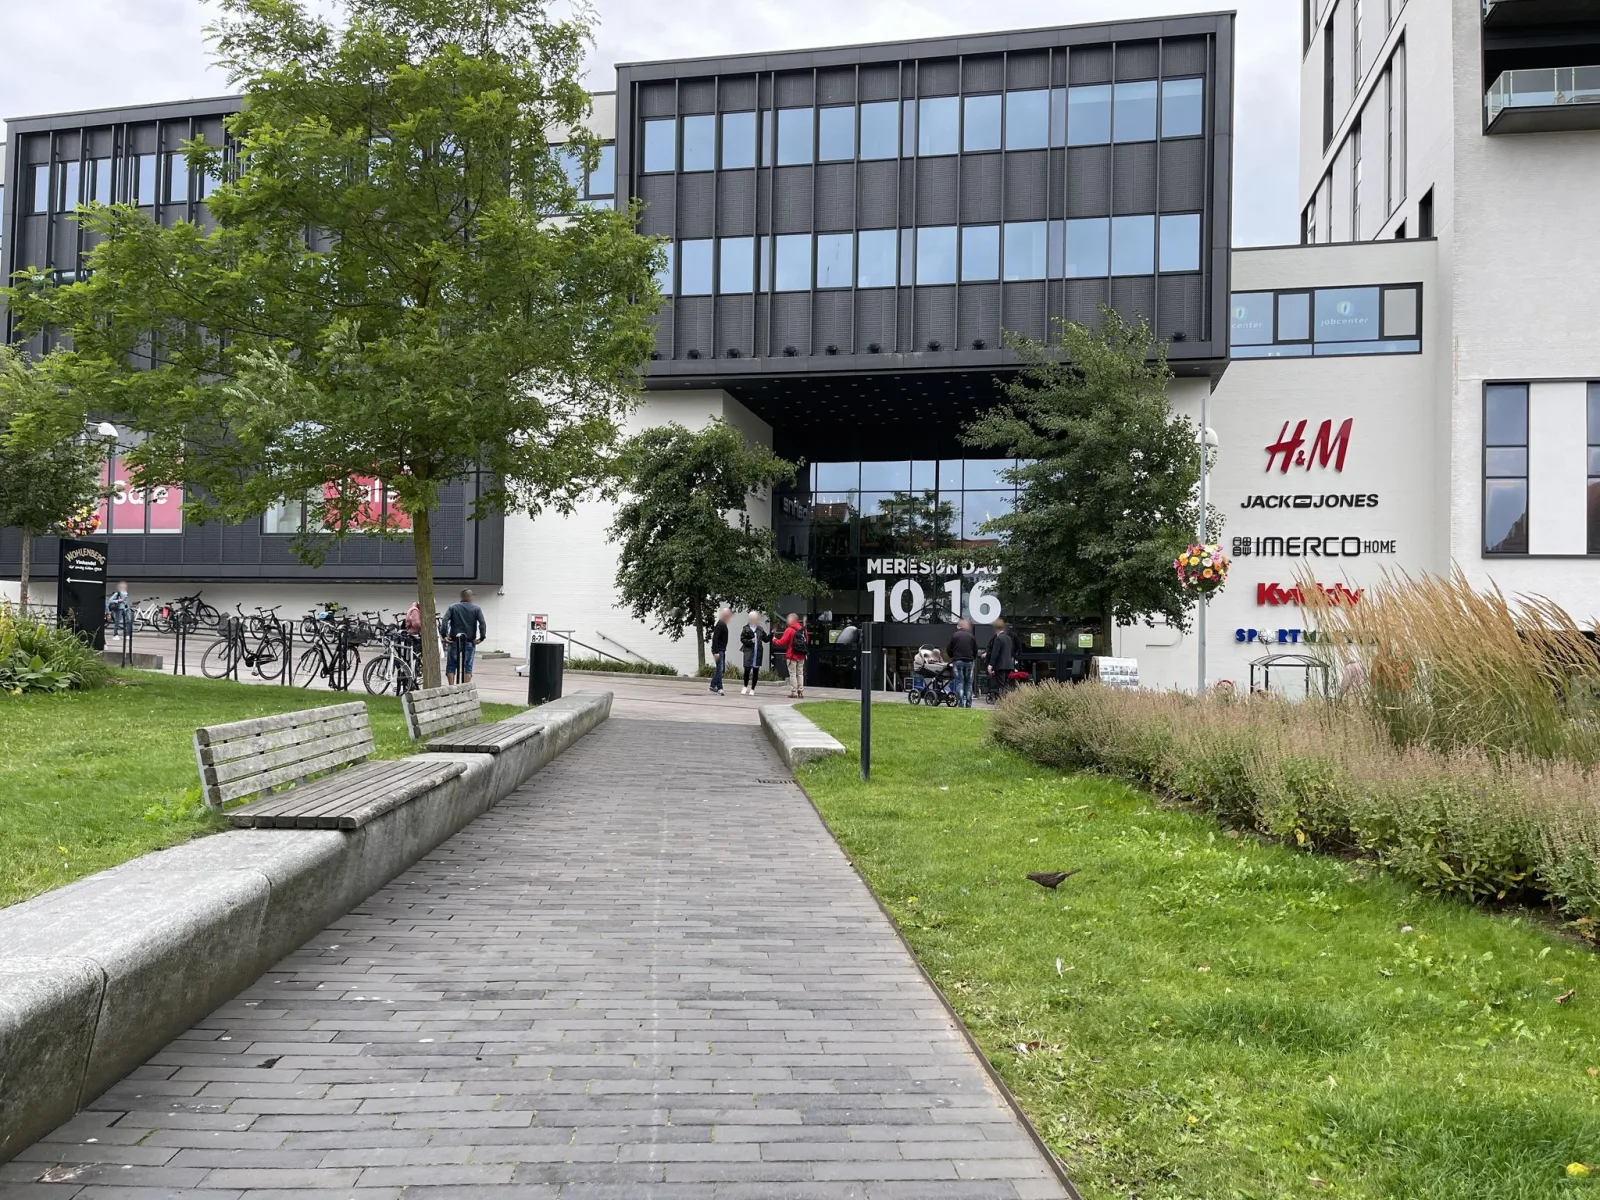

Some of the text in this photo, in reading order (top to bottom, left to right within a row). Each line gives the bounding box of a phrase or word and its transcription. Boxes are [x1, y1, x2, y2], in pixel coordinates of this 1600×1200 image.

[1320, 317, 1369, 327] jobcenter
[1265, 418, 1353, 474] H&M
[113, 479, 169, 505] Sae
[1256, 536, 1396, 557] IMERCO HOME
[866, 579, 1001, 624] 10 16
